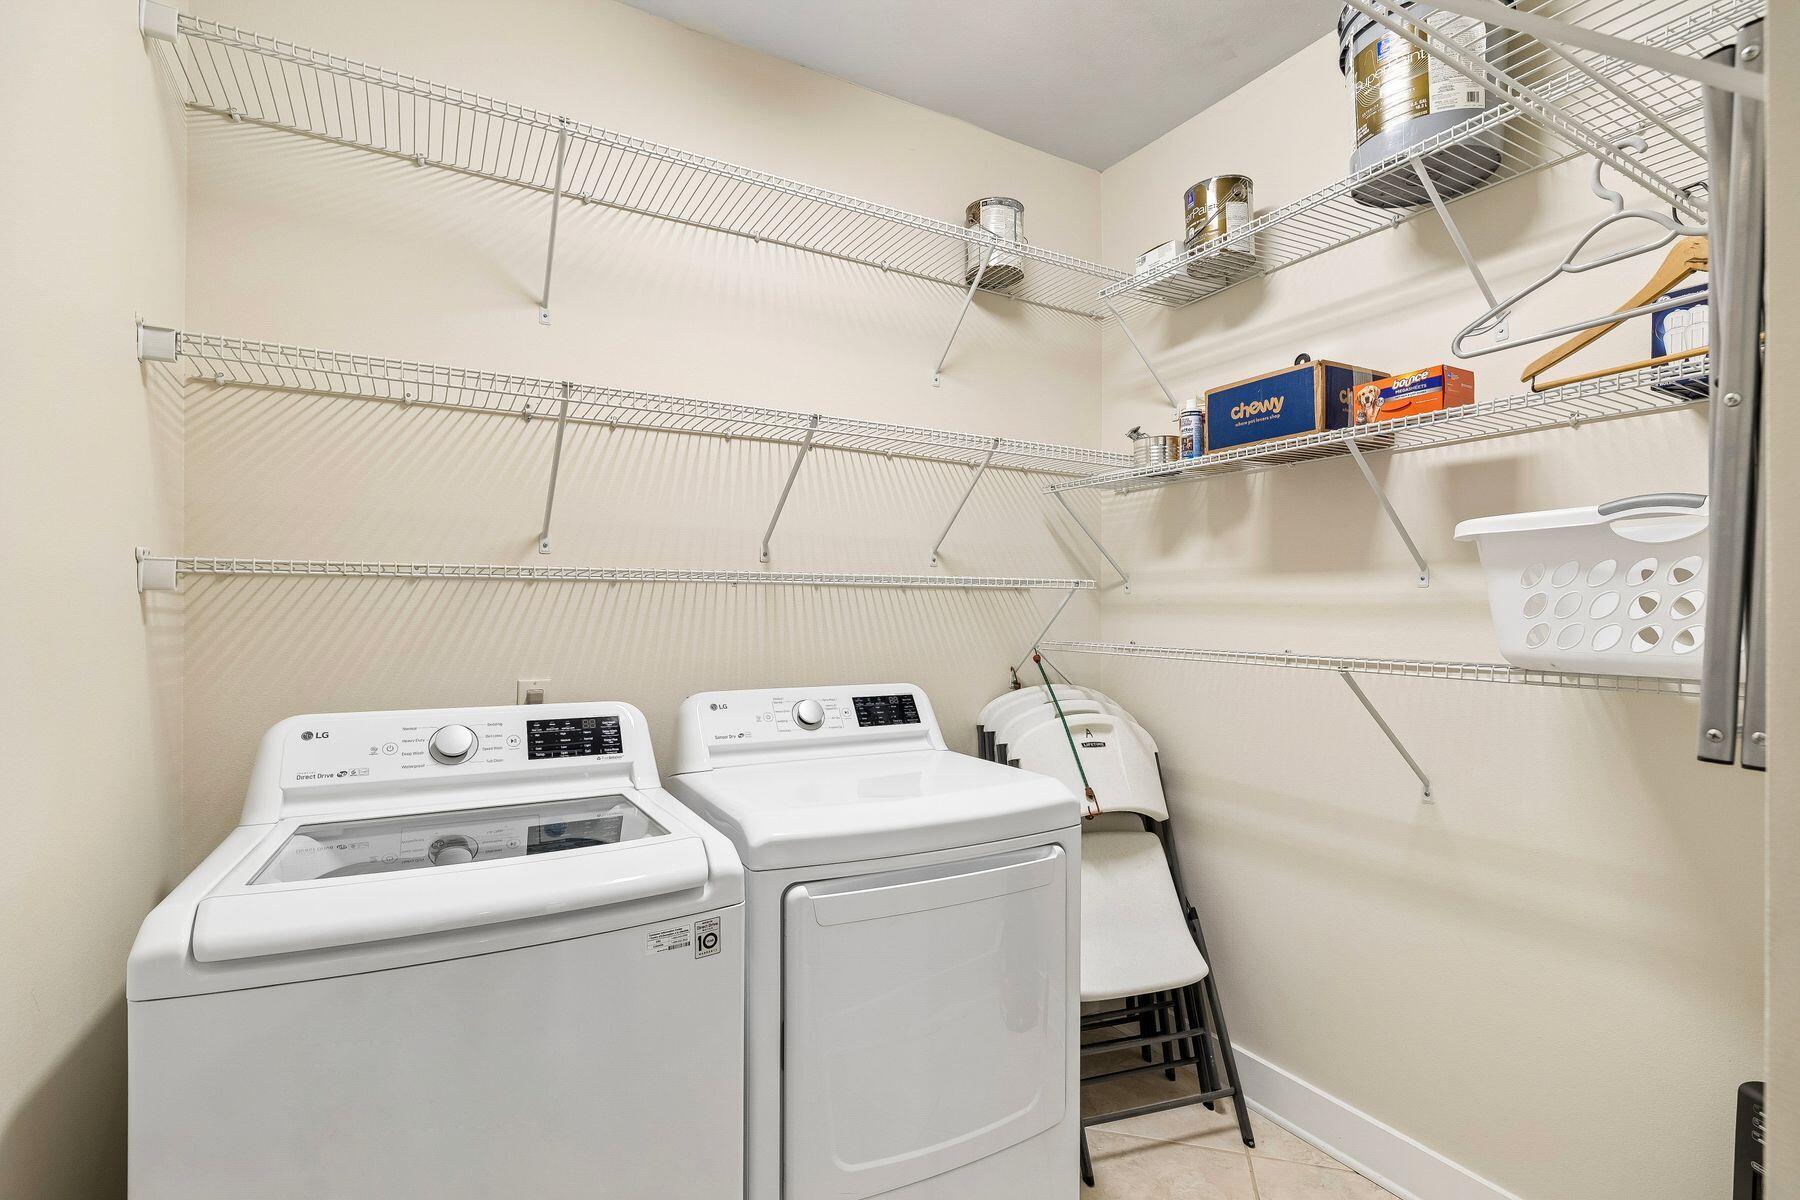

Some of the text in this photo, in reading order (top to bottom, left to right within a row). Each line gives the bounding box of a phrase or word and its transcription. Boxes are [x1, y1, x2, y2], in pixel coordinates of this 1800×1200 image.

[1392, 371, 1429, 389] bounce
[1231, 396, 1284, 419] chewy
[698, 933, 718, 951] 10
